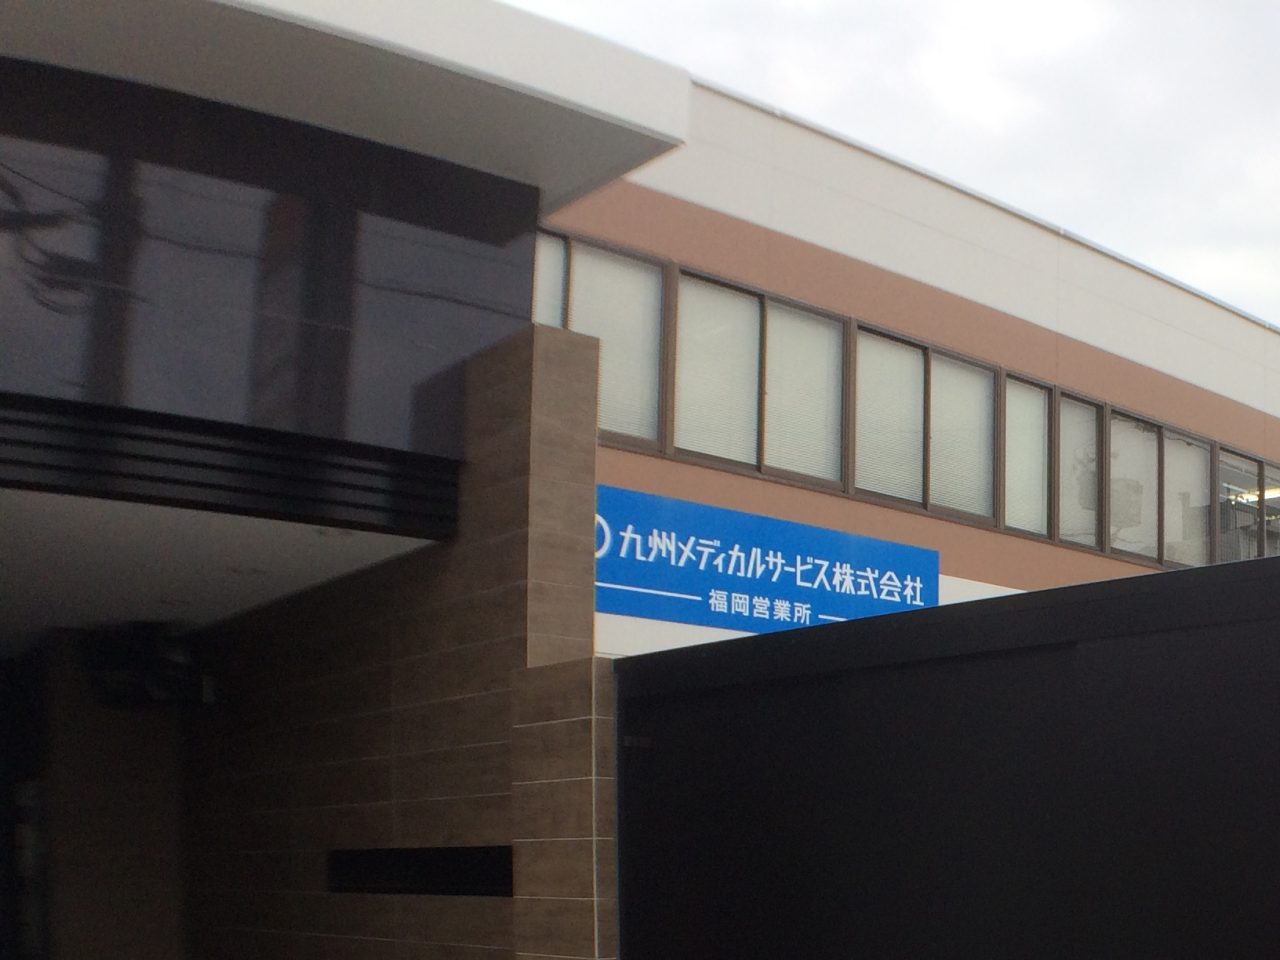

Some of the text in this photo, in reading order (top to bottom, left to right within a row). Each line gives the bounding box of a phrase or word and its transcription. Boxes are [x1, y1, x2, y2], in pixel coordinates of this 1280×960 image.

[618, 524, 925, 606] 九州メディカルサービス株式会社
[709, 588, 812, 625] 福岡営業所
